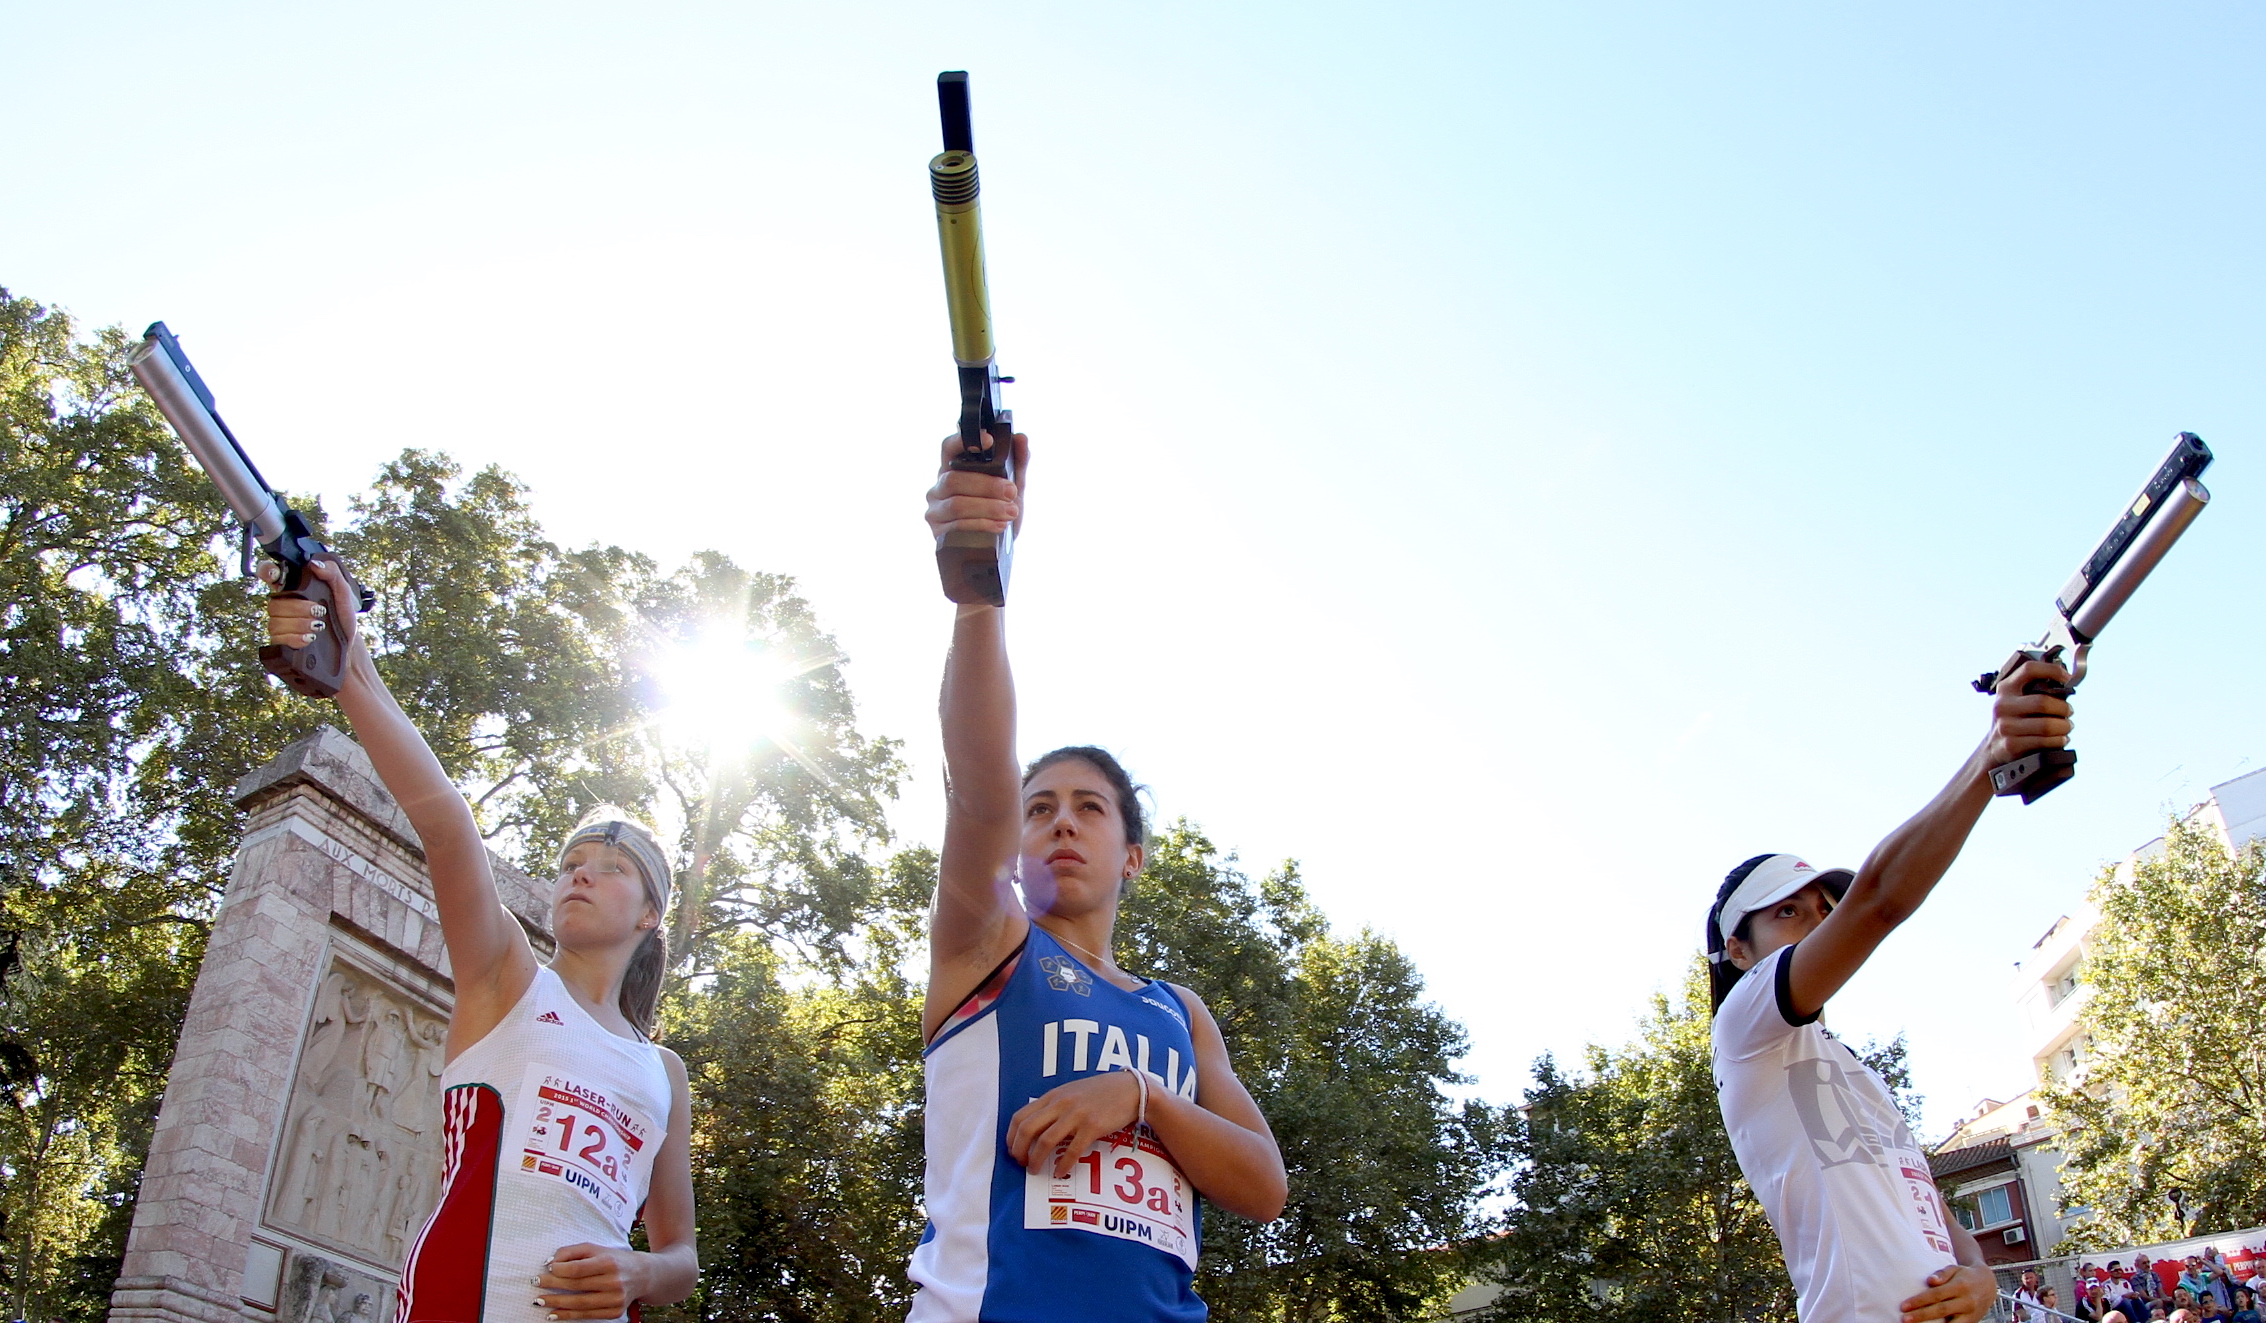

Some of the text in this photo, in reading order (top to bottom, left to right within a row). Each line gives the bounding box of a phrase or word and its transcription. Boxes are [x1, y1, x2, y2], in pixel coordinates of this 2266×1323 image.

[318, 838, 441, 921] AUX MORTS PO
[564, 1081, 632, 1128] LASER-RUN
[556, 1114, 618, 1183] 12a
[565, 1169, 600, 1199] UIPM
[1078, 1150, 1172, 1216] 13a
[1104, 1214, 1152, 1241] UIPM
